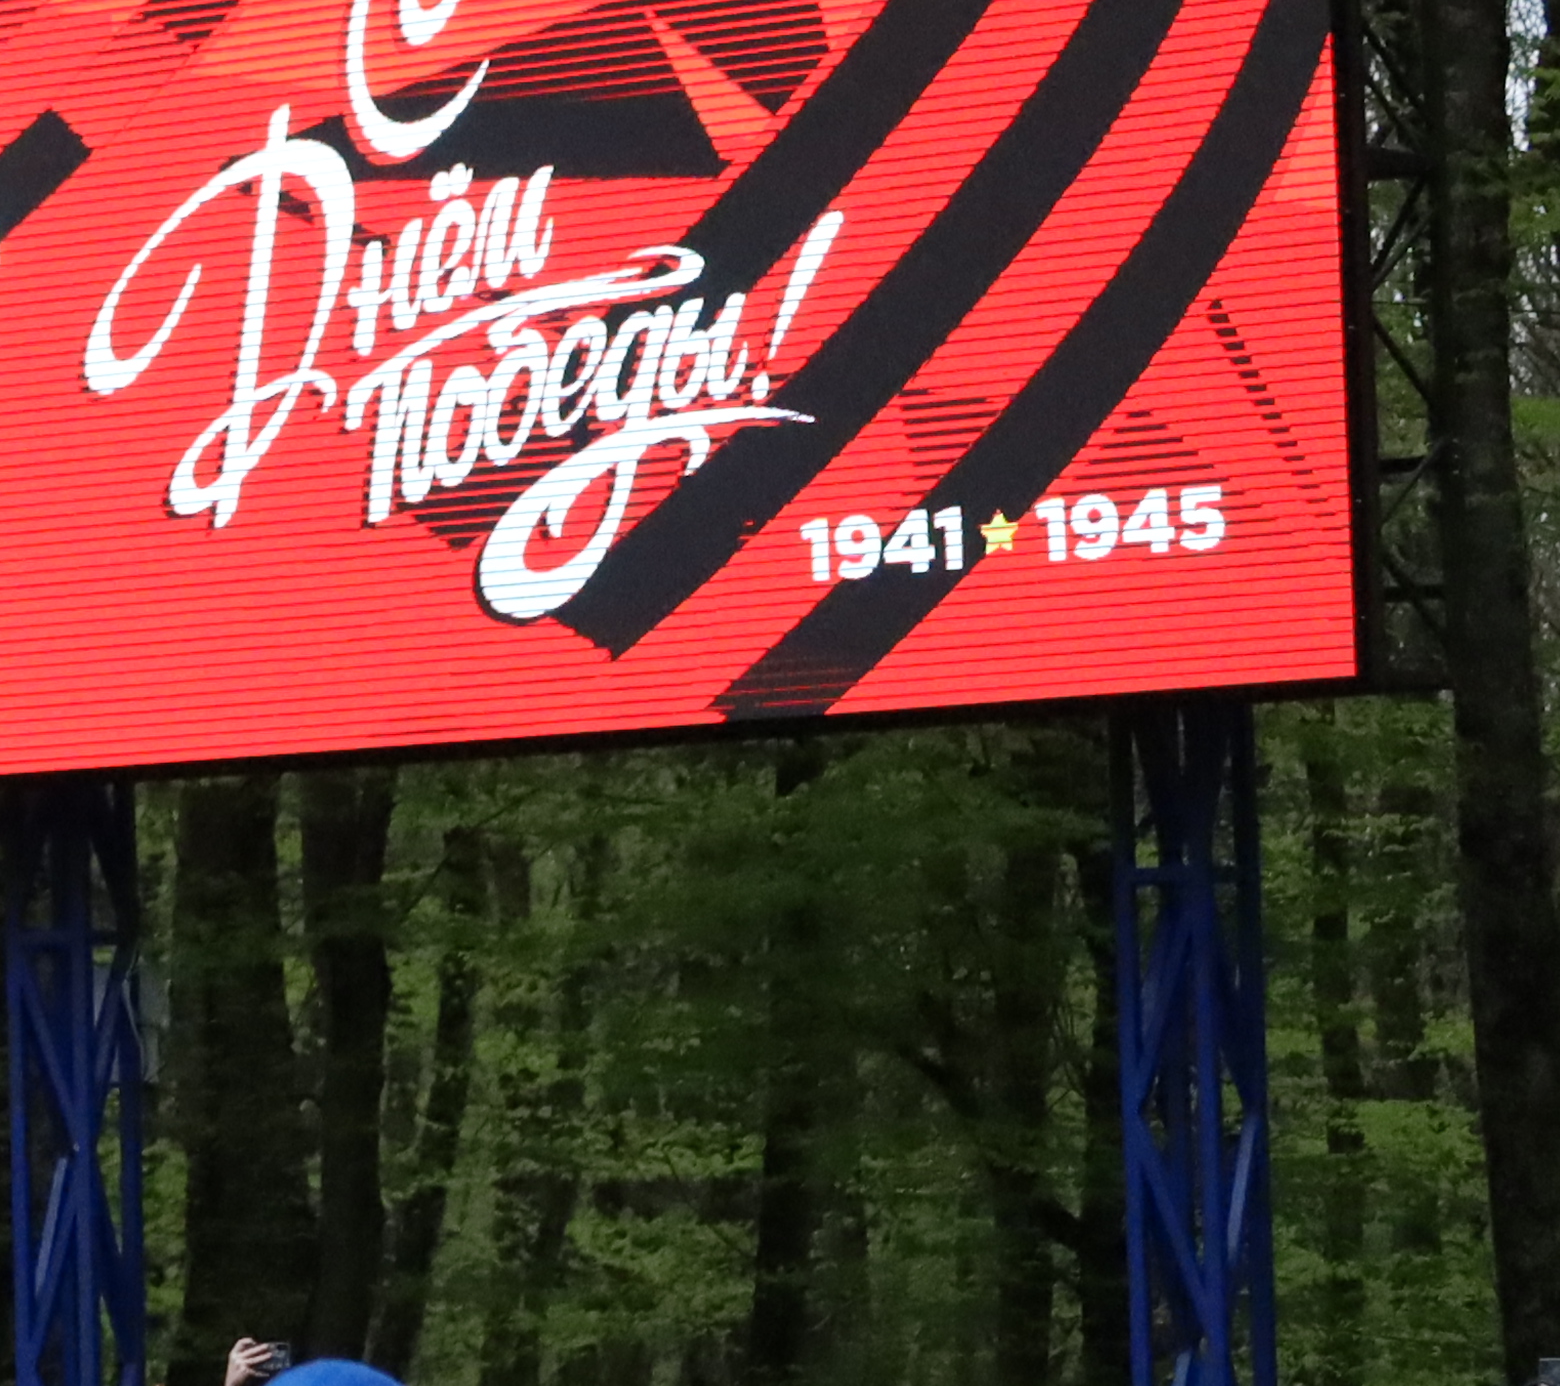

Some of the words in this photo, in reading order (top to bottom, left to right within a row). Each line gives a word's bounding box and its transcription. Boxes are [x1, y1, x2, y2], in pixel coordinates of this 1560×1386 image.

[83, 104, 556, 530] Днём
[344, 212, 845, 619] Победы!
[799, 505, 964, 582] 1941
[1034, 484, 1227, 563] 1945
